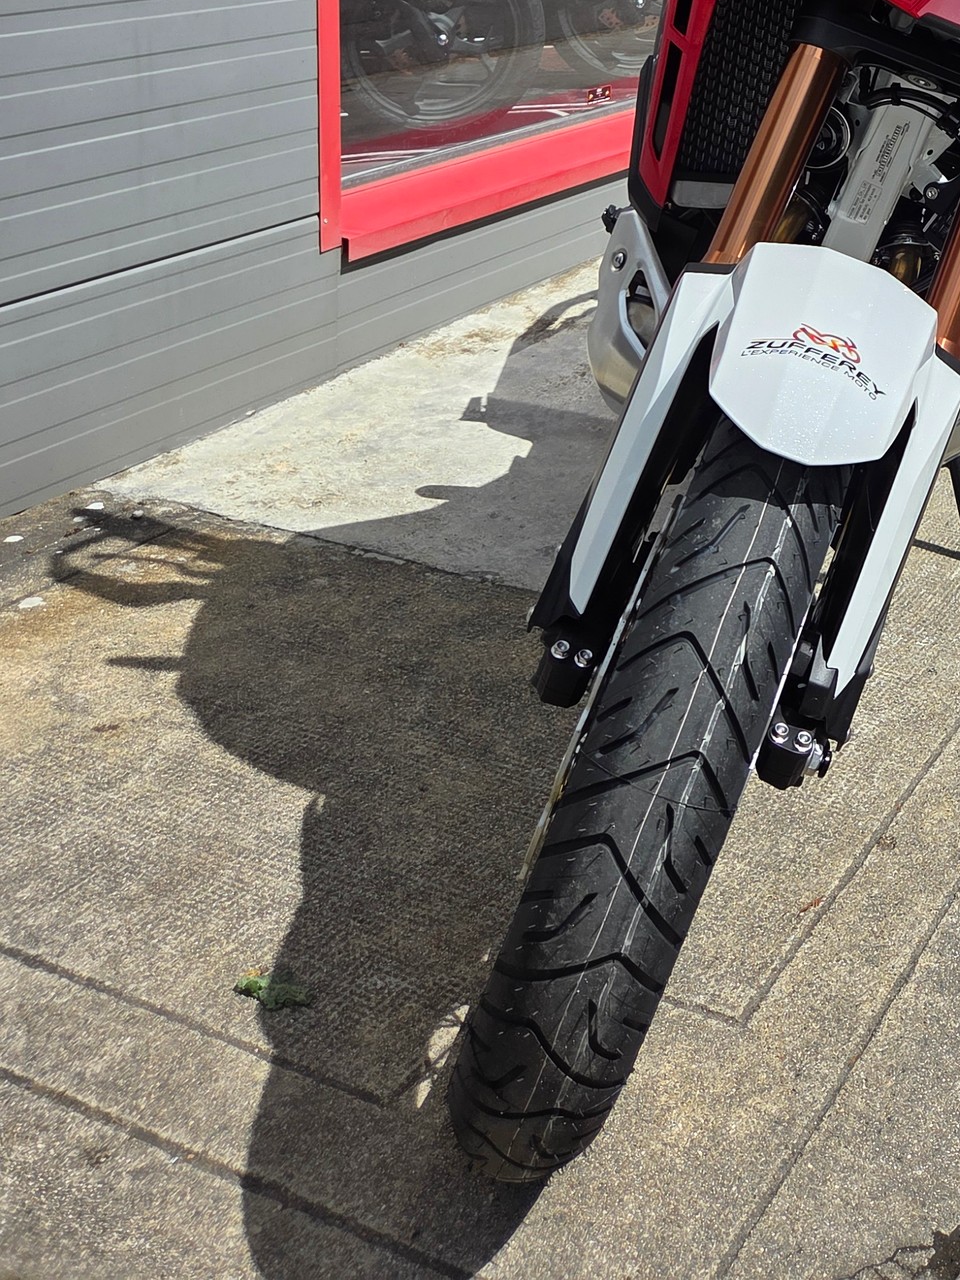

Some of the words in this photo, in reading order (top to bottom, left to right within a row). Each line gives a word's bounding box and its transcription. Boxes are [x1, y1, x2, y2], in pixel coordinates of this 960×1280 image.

[740, 349, 840, 372] L'EXPERIENCE
[843, 370, 877, 401] MOTO
[746, 340, 886, 396] ZUFFEREY
